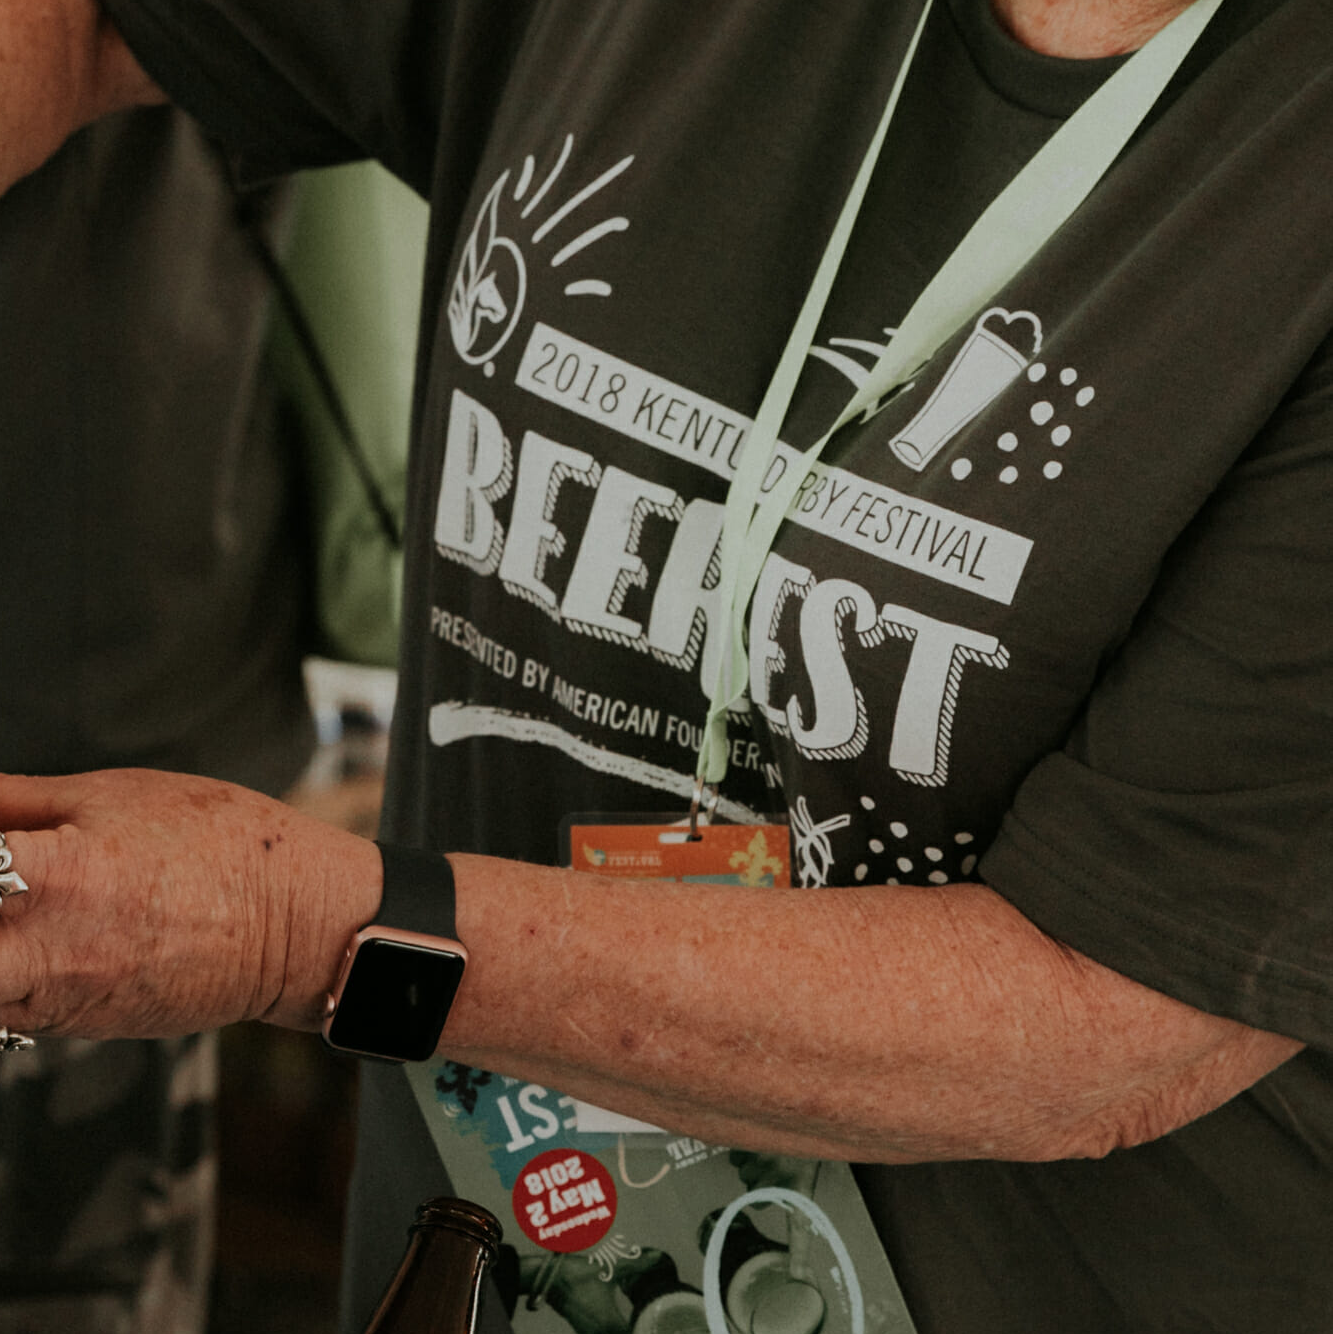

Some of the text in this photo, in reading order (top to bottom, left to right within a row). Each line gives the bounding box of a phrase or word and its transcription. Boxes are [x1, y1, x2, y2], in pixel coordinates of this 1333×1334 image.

[529, 340, 992, 583] 2018 KENTU DRBY FESTIVAL
[433, 388, 1012, 788] BEEREST
[430, 606, 765, 771] PRESNTED BY AMERICAN FOUER
[523, 1154, 585, 1196] 2018
[524, 1177, 606, 1228] May 2
[537, 1204, 612, 1242] Wednesday
